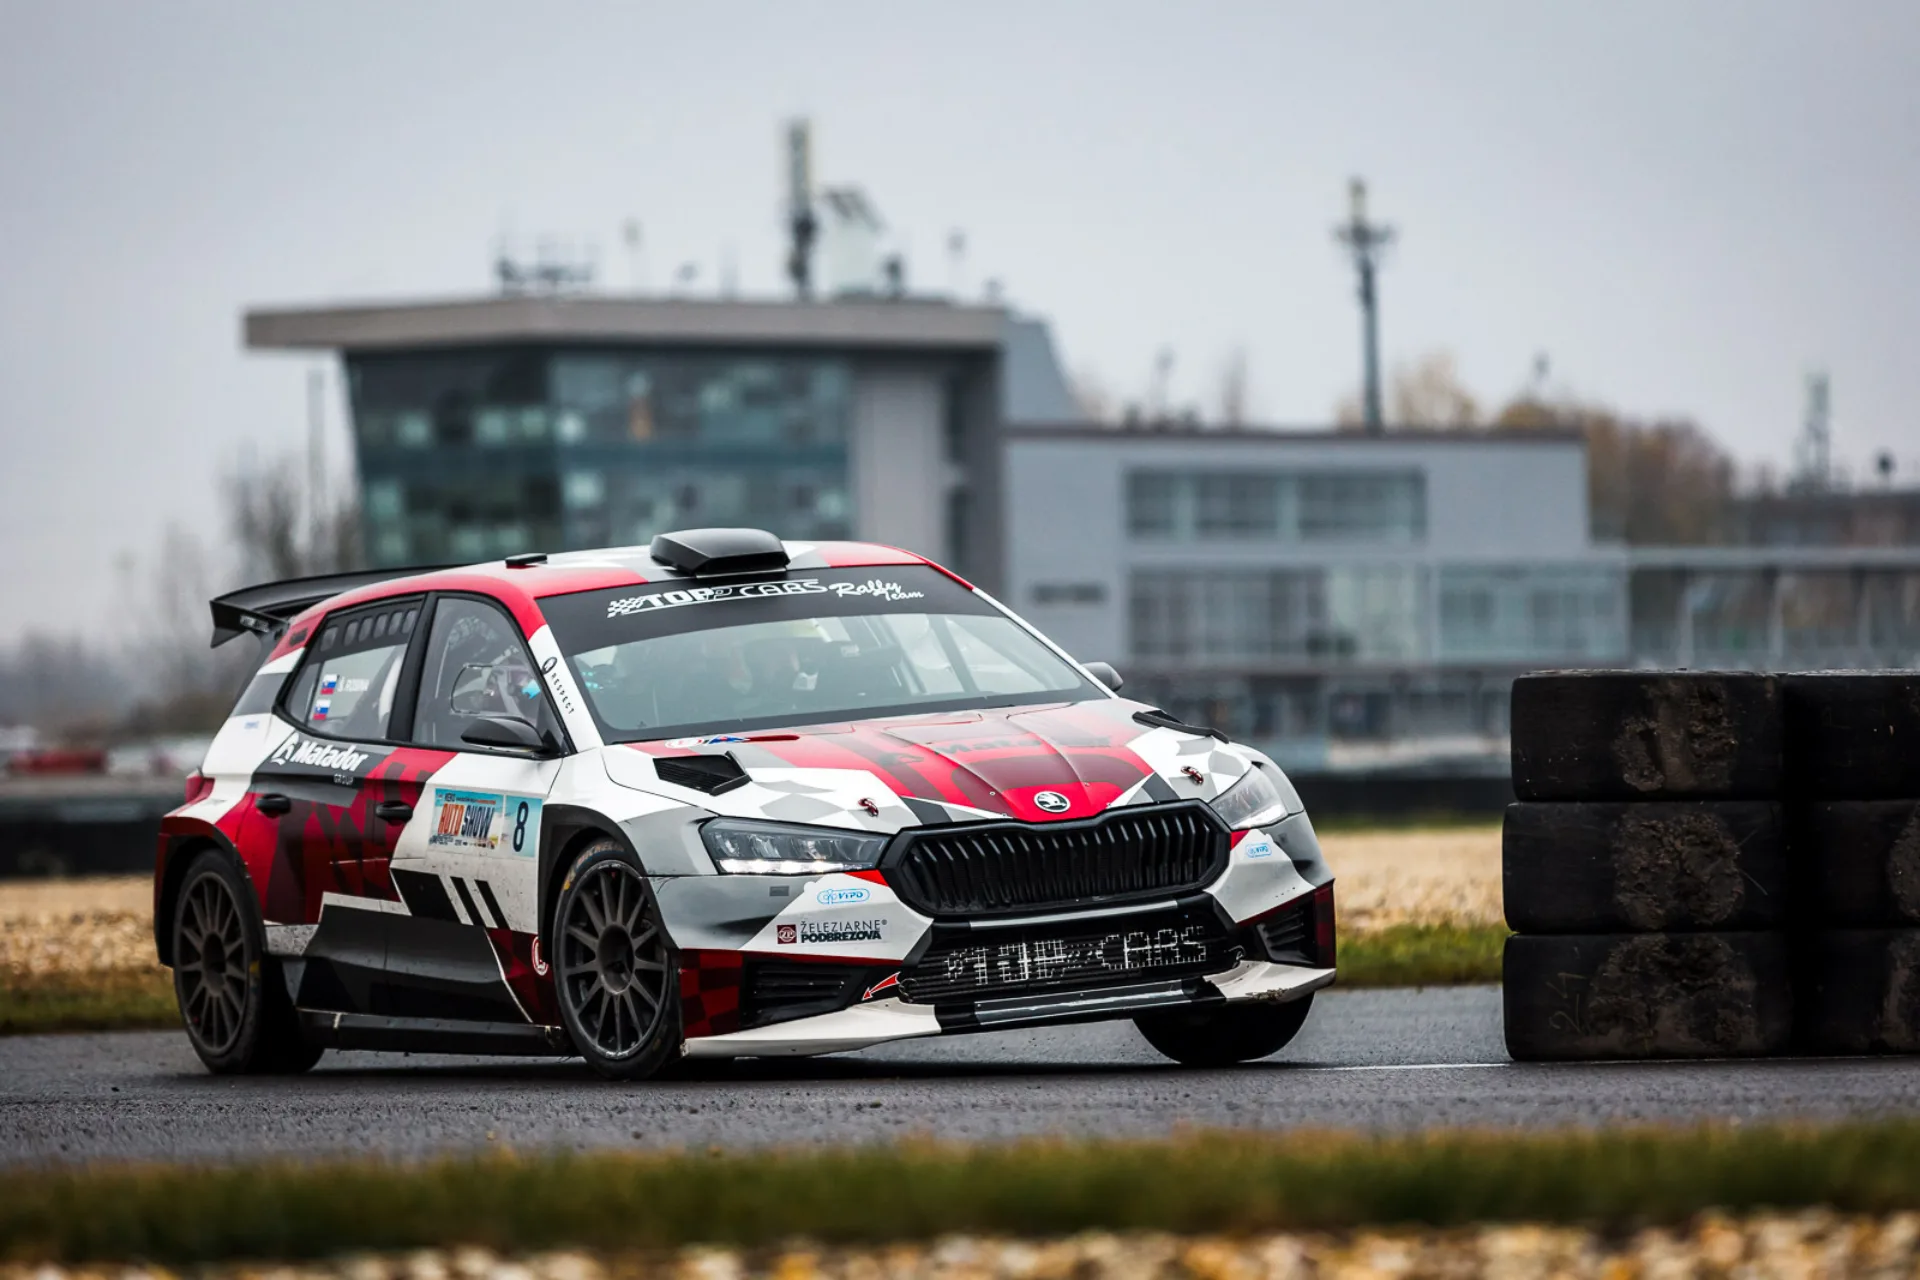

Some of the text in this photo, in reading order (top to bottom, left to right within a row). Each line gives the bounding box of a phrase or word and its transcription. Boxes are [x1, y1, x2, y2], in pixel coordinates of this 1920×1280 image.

[739, 580, 827, 598] CARS
[828, 579, 901, 597] Rally
[290, 740, 369, 772] Matador
[437, 803, 495, 839] AUTO SHOW
[513, 801, 529, 852] 8
[800, 919, 880, 933] ŽELEZIARNE
